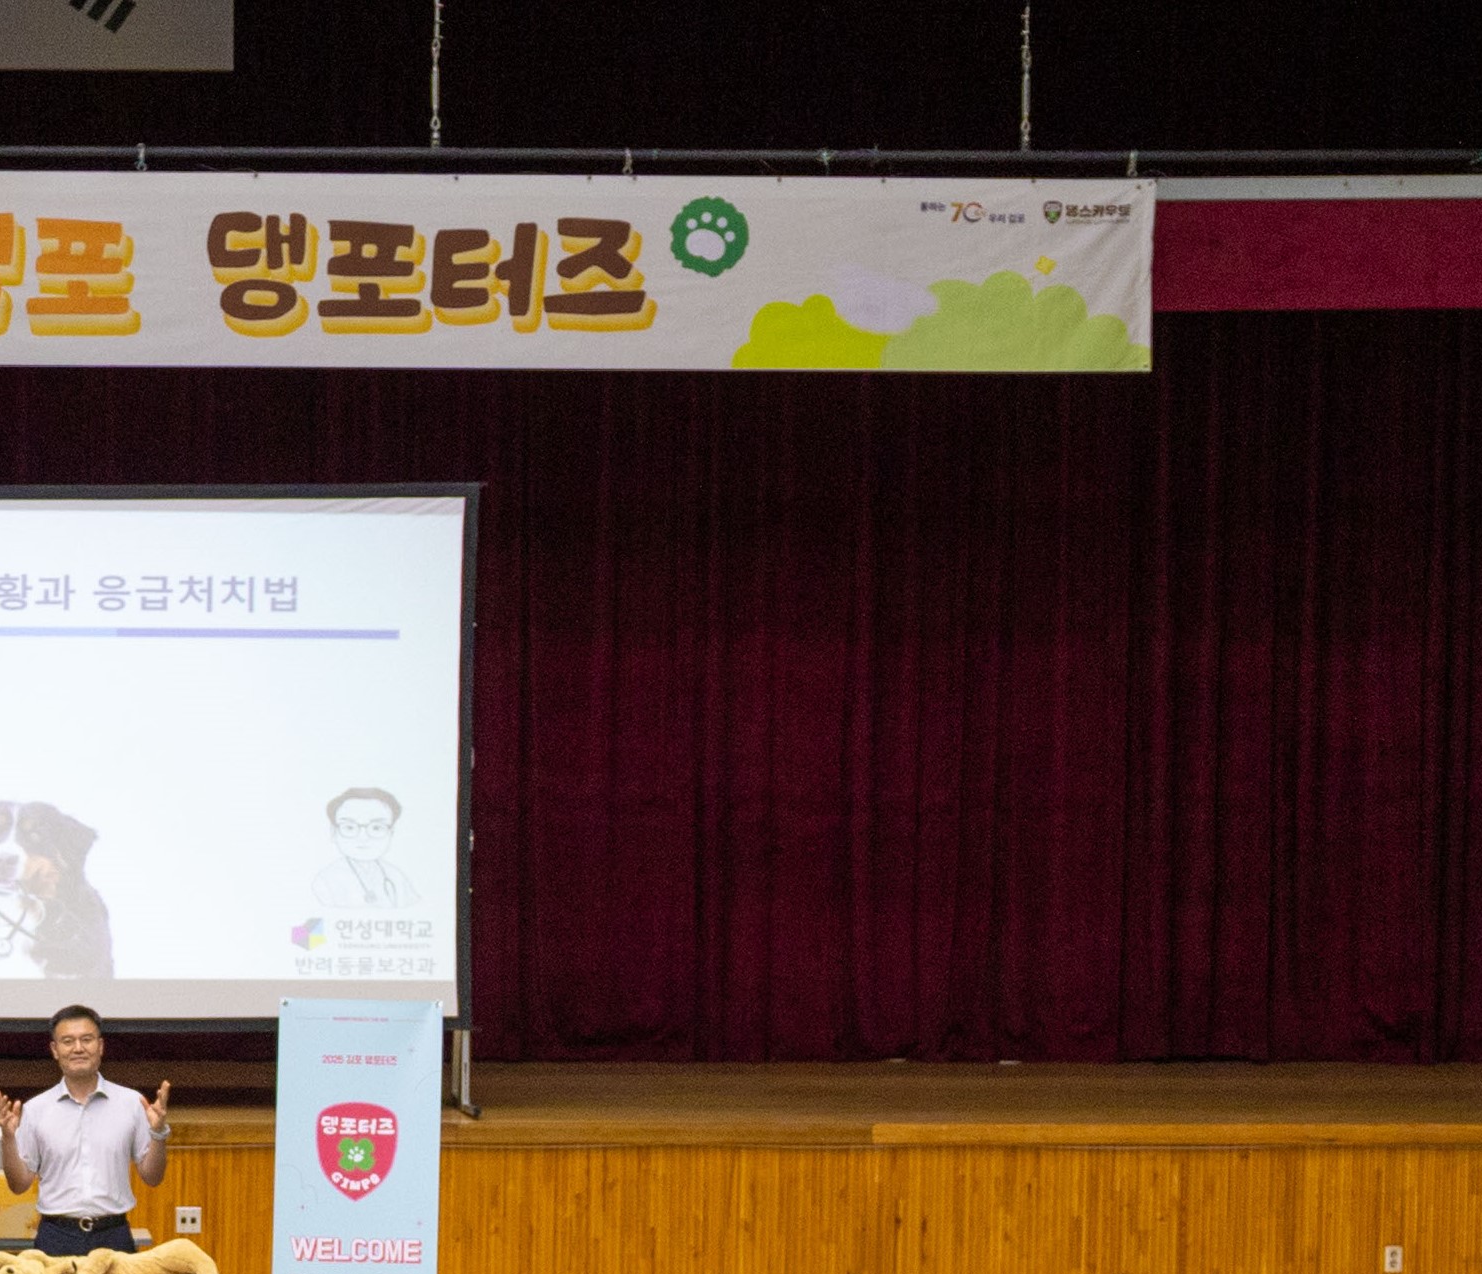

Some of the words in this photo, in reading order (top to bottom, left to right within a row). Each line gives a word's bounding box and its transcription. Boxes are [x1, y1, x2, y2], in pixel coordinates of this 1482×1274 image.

[206, 209, 658, 337] 댕포터즈
[92, 574, 300, 614] 응급처치법
[335, 919, 434, 940] 연성대학교
[294, 957, 437, 976] 반려동물보건과
[320, 1114, 396, 1136] 댕포터즈
[330, 1171, 381, 1192] GIMPO
[290, 1236, 422, 1264] WELCOME
